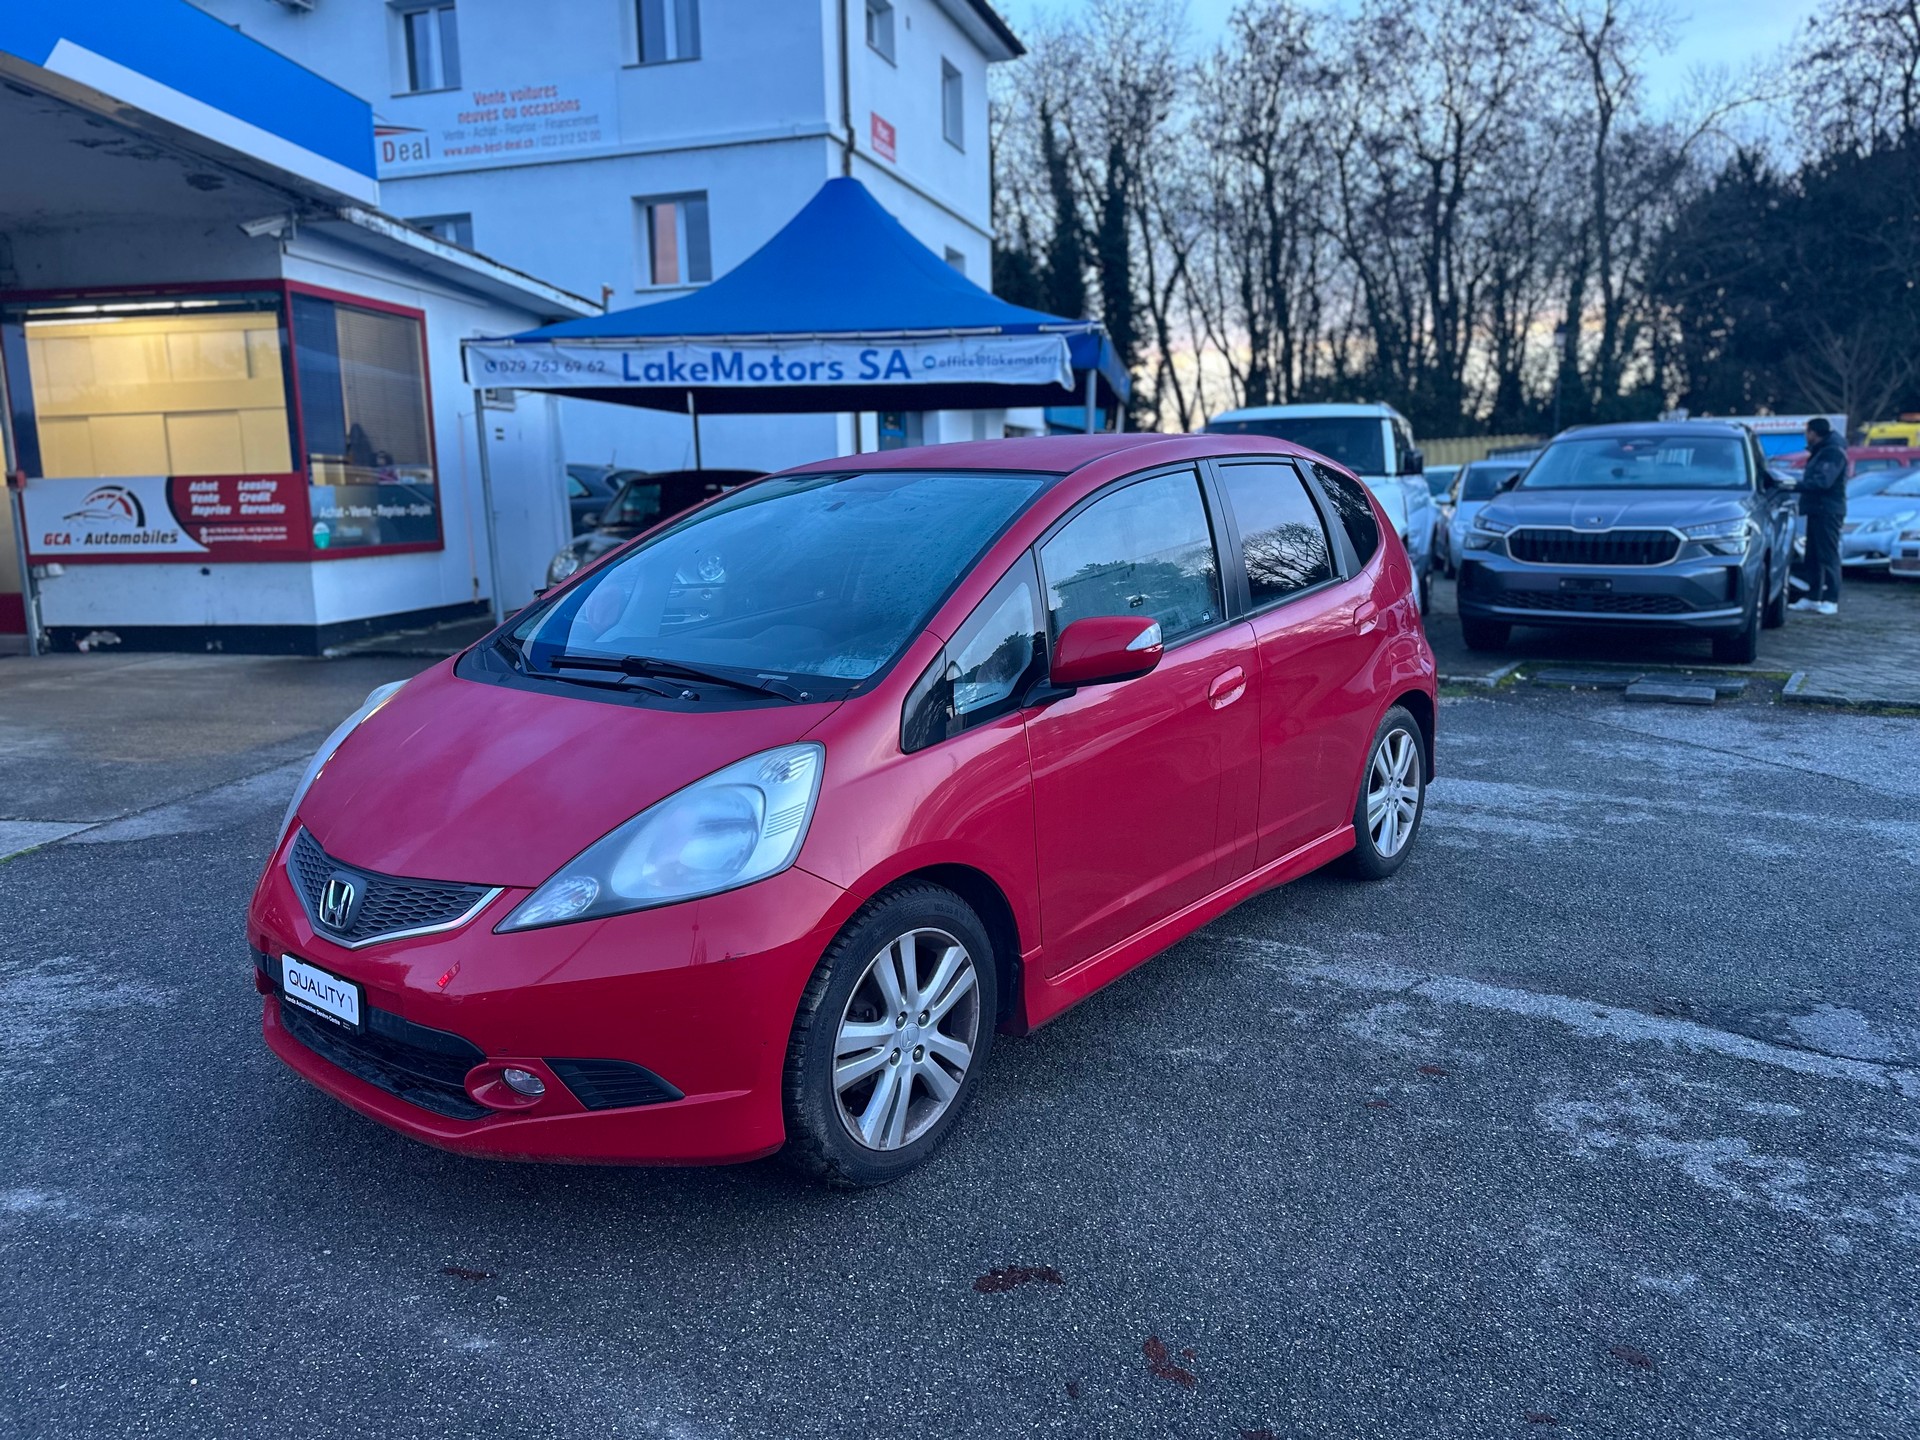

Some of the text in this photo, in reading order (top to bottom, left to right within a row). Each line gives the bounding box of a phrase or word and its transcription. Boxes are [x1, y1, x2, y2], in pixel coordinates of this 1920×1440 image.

[472, 85, 558, 106] Vente voitures
[458, 99, 581, 124] neuves ou occasions
[382, 136, 431, 163] Deal
[500, 360, 527, 373] 079
[532, 360, 559, 373] 753
[564, 360, 582, 373] 69
[587, 360, 605, 373] 62
[622, 351, 844, 382] LakeMotors
[858, 349, 912, 380] SA
[188, 479, 278, 493] Achat Leasing
[190, 493, 220, 503] Vente
[191, 502, 286, 517] Reprise Garantie
[43, 533, 72, 546] GCA
[84, 530, 178, 546] Automobiles
